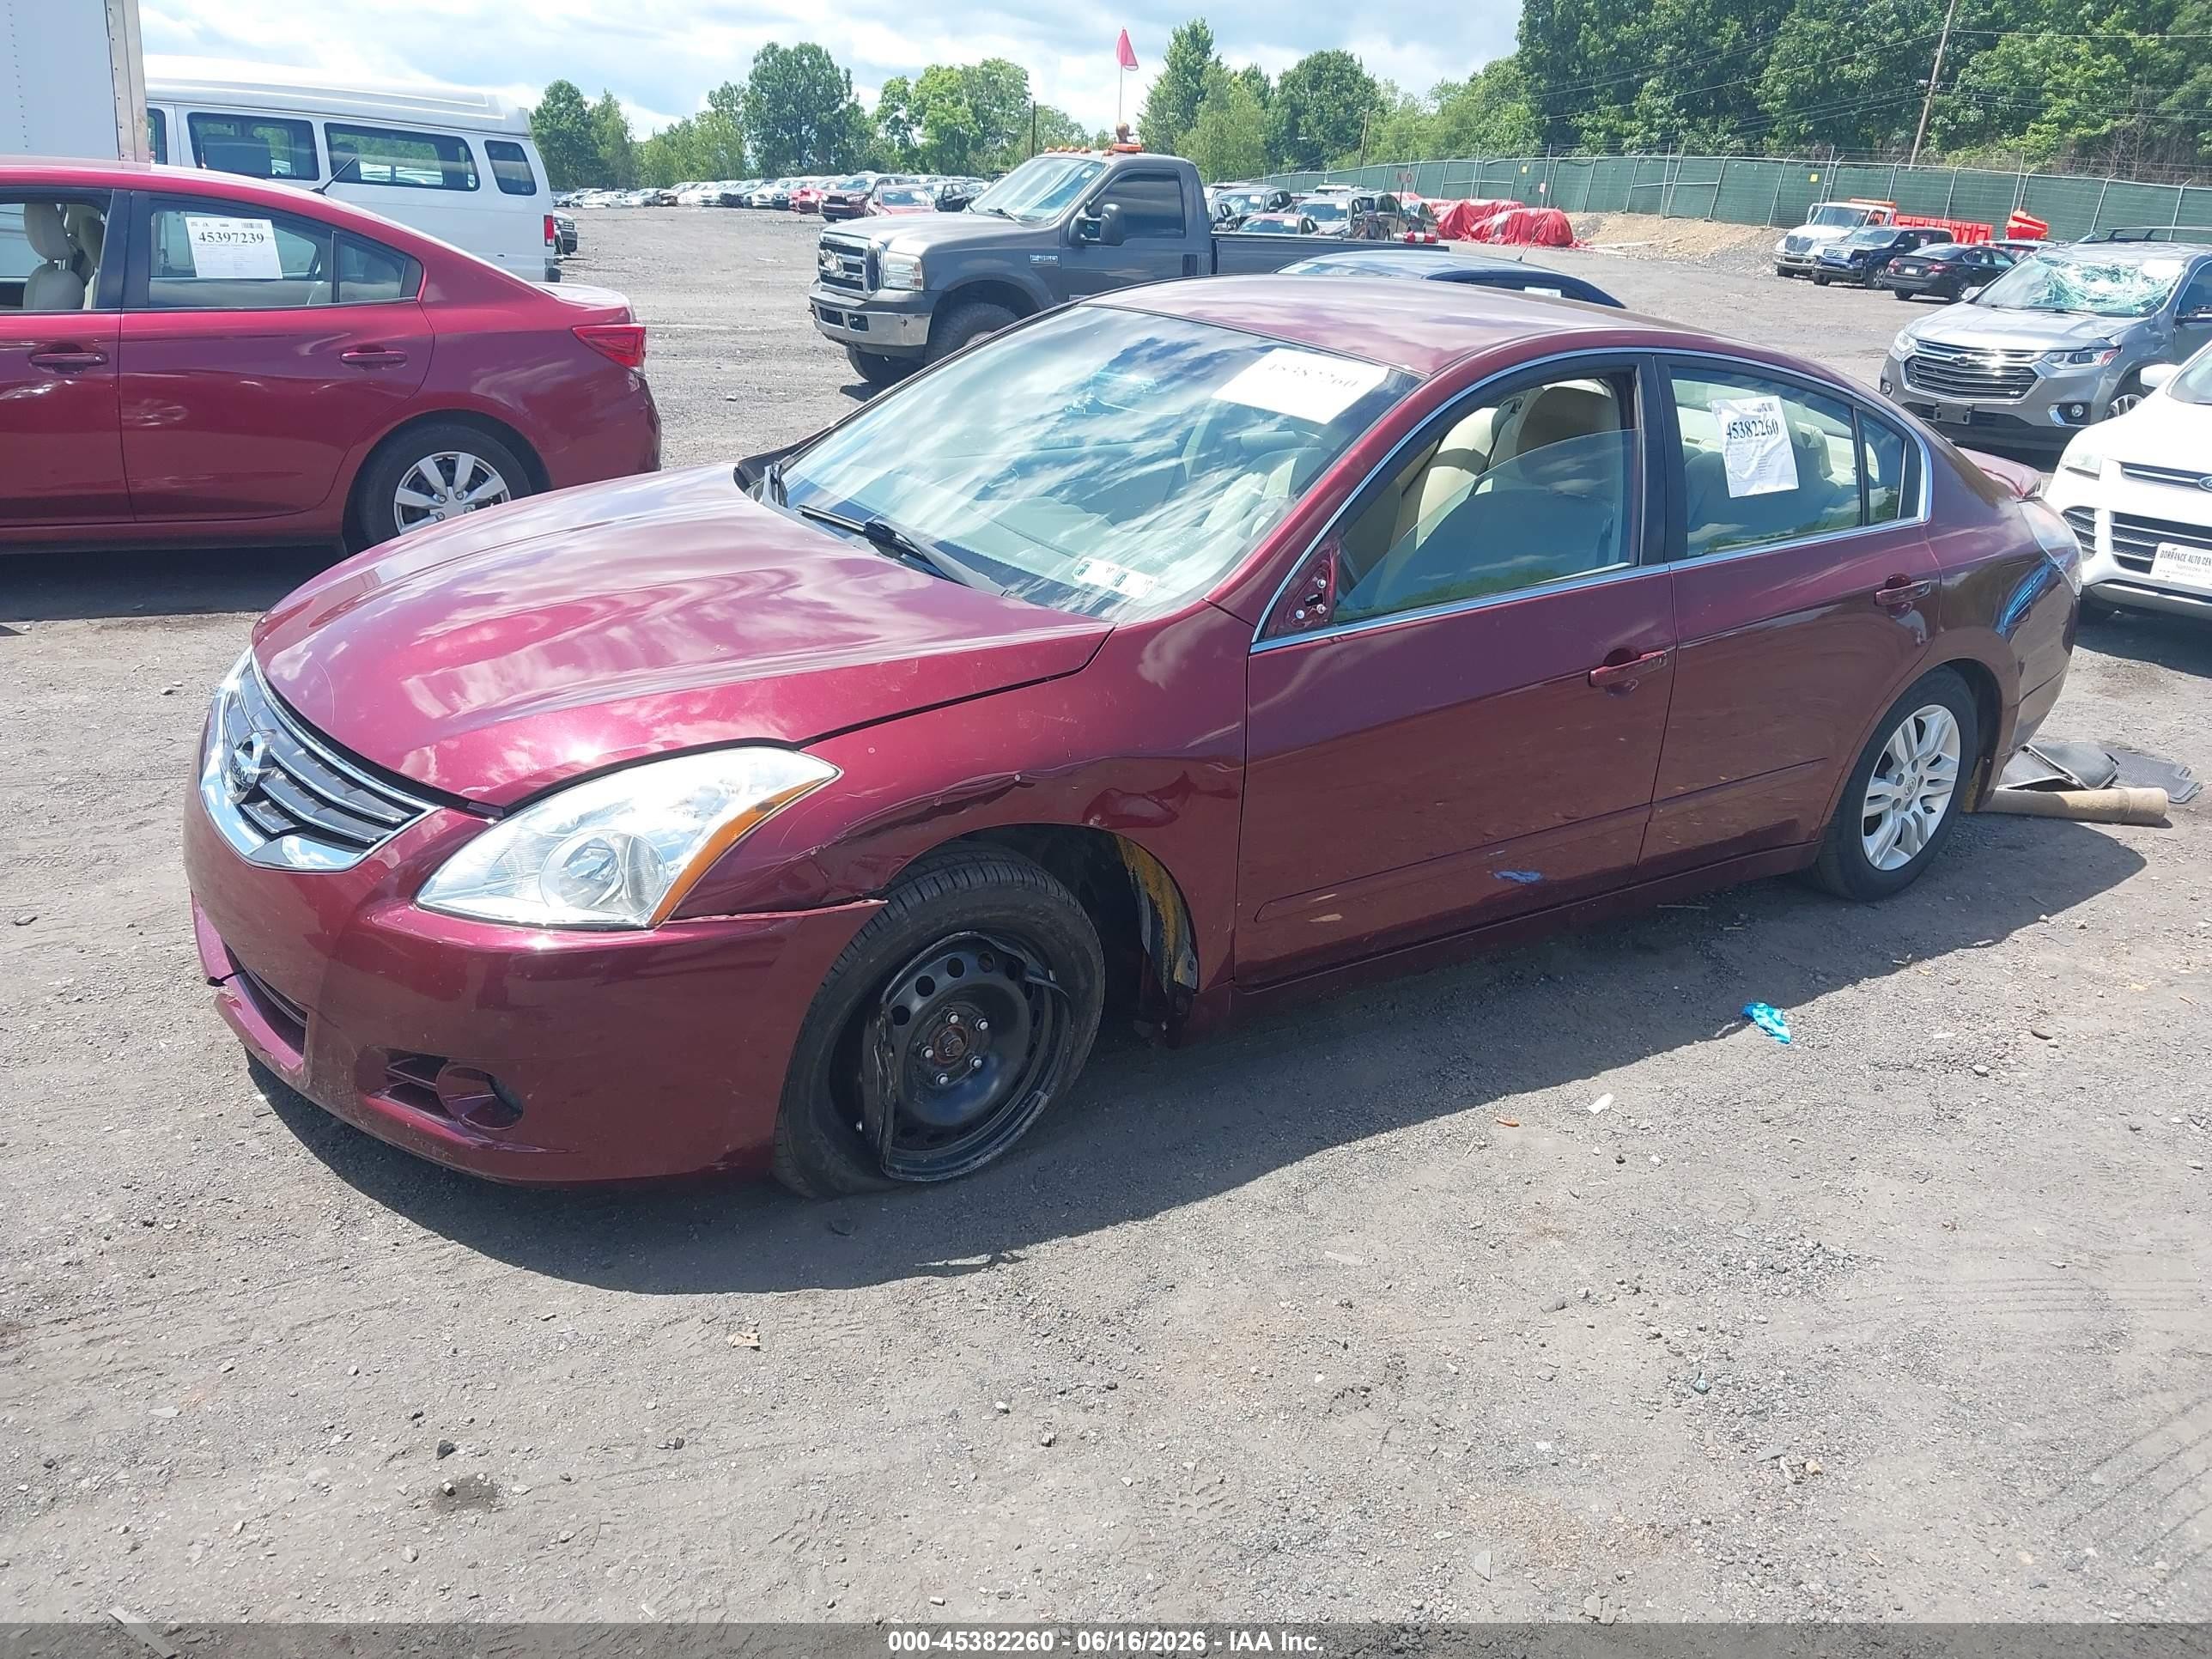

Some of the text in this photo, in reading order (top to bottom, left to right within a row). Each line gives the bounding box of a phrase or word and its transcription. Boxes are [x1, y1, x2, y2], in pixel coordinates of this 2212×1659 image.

[198, 232, 264, 244] 45397239
[1726, 418, 1779, 440] 45382260
[2188, 555, 2202, 565] AUTO
